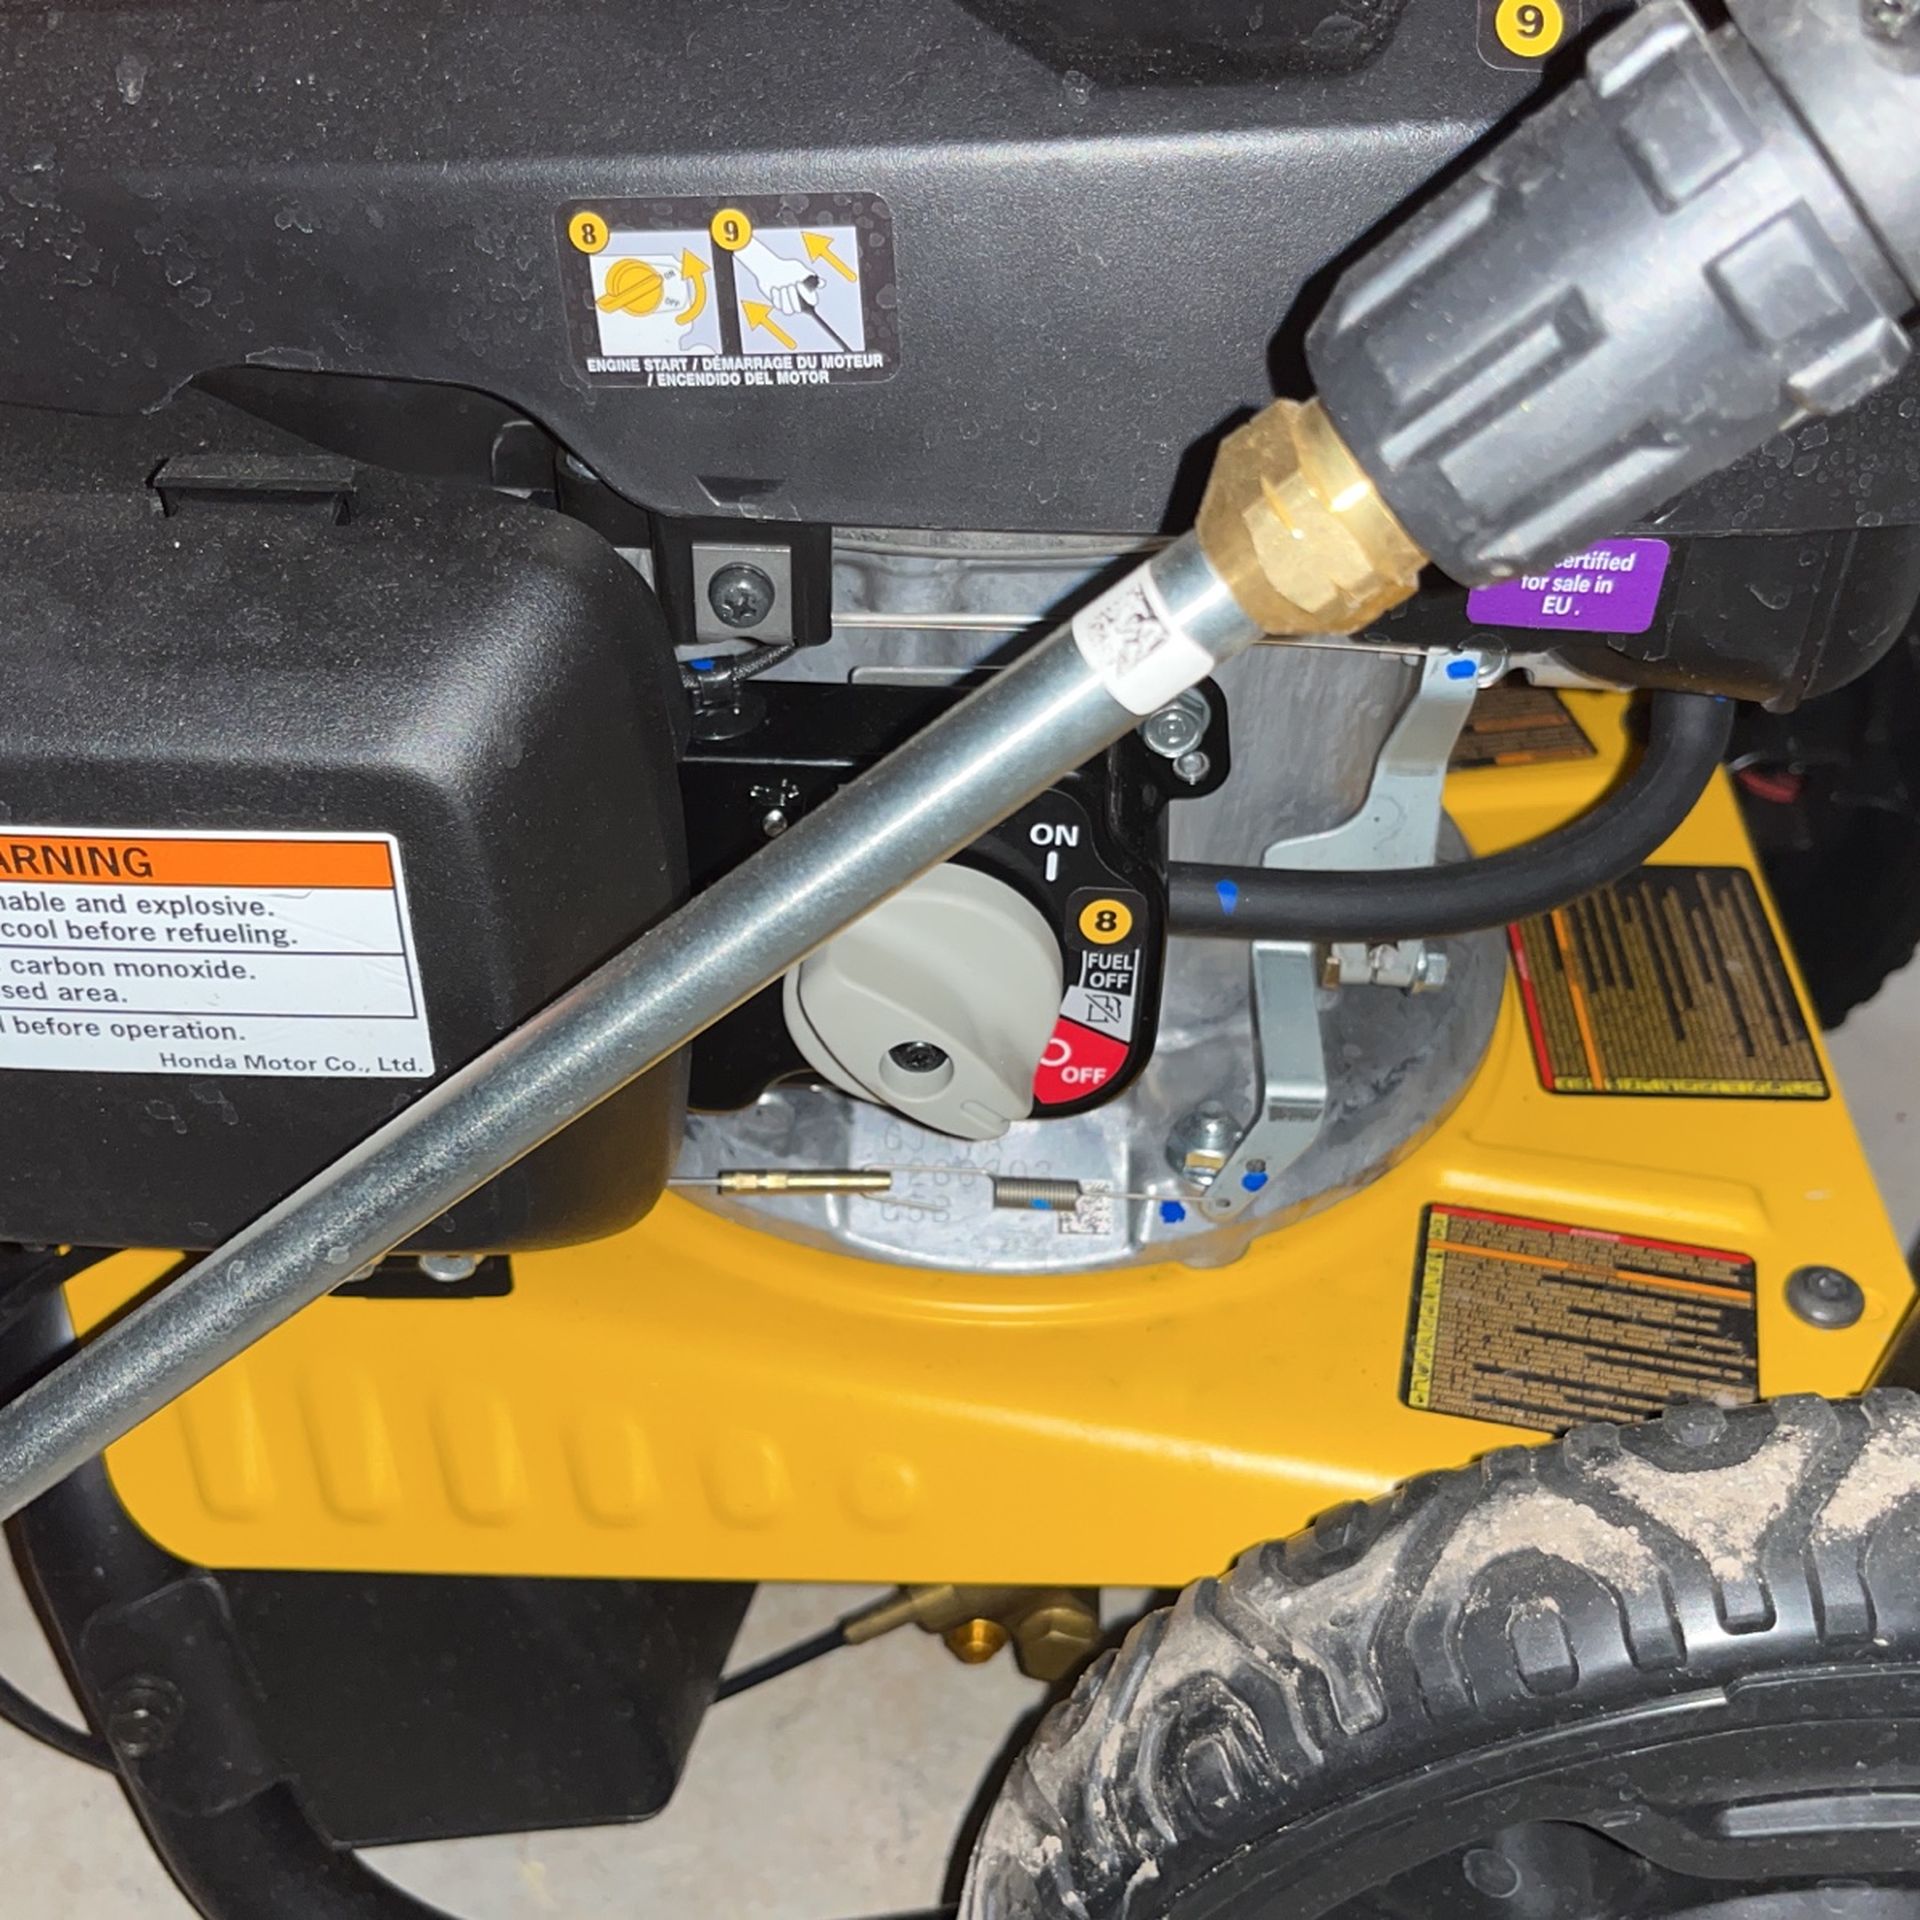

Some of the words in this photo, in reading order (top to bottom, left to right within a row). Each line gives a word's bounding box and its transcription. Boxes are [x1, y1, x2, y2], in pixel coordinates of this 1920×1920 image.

[1516, 4, 1544, 39] 9
[581, 222, 597, 245] 8
[723, 219, 739, 243] 9
[587, 358, 641, 373] ENGINE
[644, 357, 688, 372] START
[702, 354, 793, 371] DÉMARRAGE
[796, 356, 817, 370] DU
[822, 354, 883, 369] MOTEUR
[658, 372, 742, 387] ENCENDIDO
[745, 372, 774, 386] DEL
[776, 370, 830, 385] MOTOR
[1554, 551, 1636, 572] ertified
[1551, 573, 1590, 594] sale
[1593, 576, 1614, 594] in
[1029, 823, 1079, 847] ON
[0, 891, 66, 912] able
[76, 893, 127, 914] and
[136, 895, 275, 918] explosive.
[1094, 910, 1117, 932] 8
[0, 919, 58, 939] cool
[66, 919, 156, 941] before
[166, 923, 299, 948] refueling.
[10, 956, 105, 976] carbon
[114, 959, 256, 980] monoxide.
[1087, 952, 1134, 972] FUEL
[1089, 971, 1129, 990] OFF
[57, 986, 128, 1003] area.
[12, 1016, 101, 1037] before
[110, 1021, 246, 1041] operation.
[160, 1052, 237, 1070] Honda
[243, 1055, 317, 1072] Motor
[324, 1056, 370, 1074] Co.,
[378, 1057, 424, 1073] Ltd.
[1061, 1066, 1107, 1085] OFF
